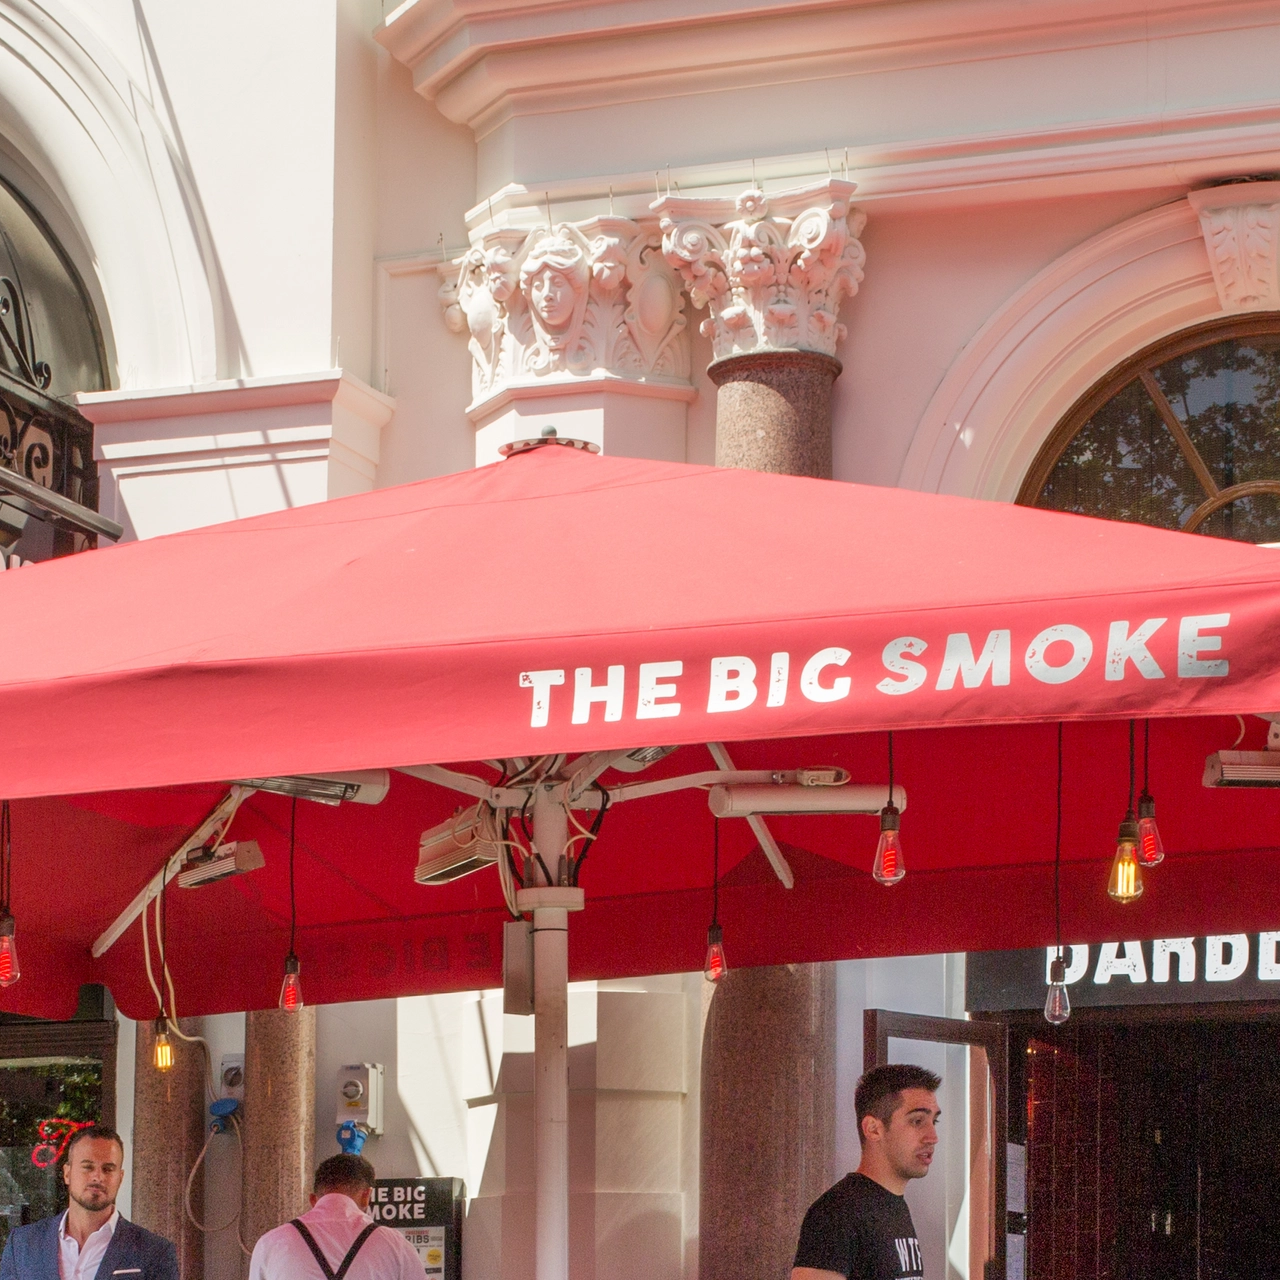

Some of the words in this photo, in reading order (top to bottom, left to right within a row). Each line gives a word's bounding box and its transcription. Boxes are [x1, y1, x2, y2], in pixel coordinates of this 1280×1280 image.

[521, 659, 684, 729] THE
[706, 645, 853, 715] BIG
[876, 611, 1231, 697] SMOKE
[393, 1185, 426, 1202] BIG
[367, 1203, 426, 1221] MOKE
[405, 1235, 430, 1244] RIBS
